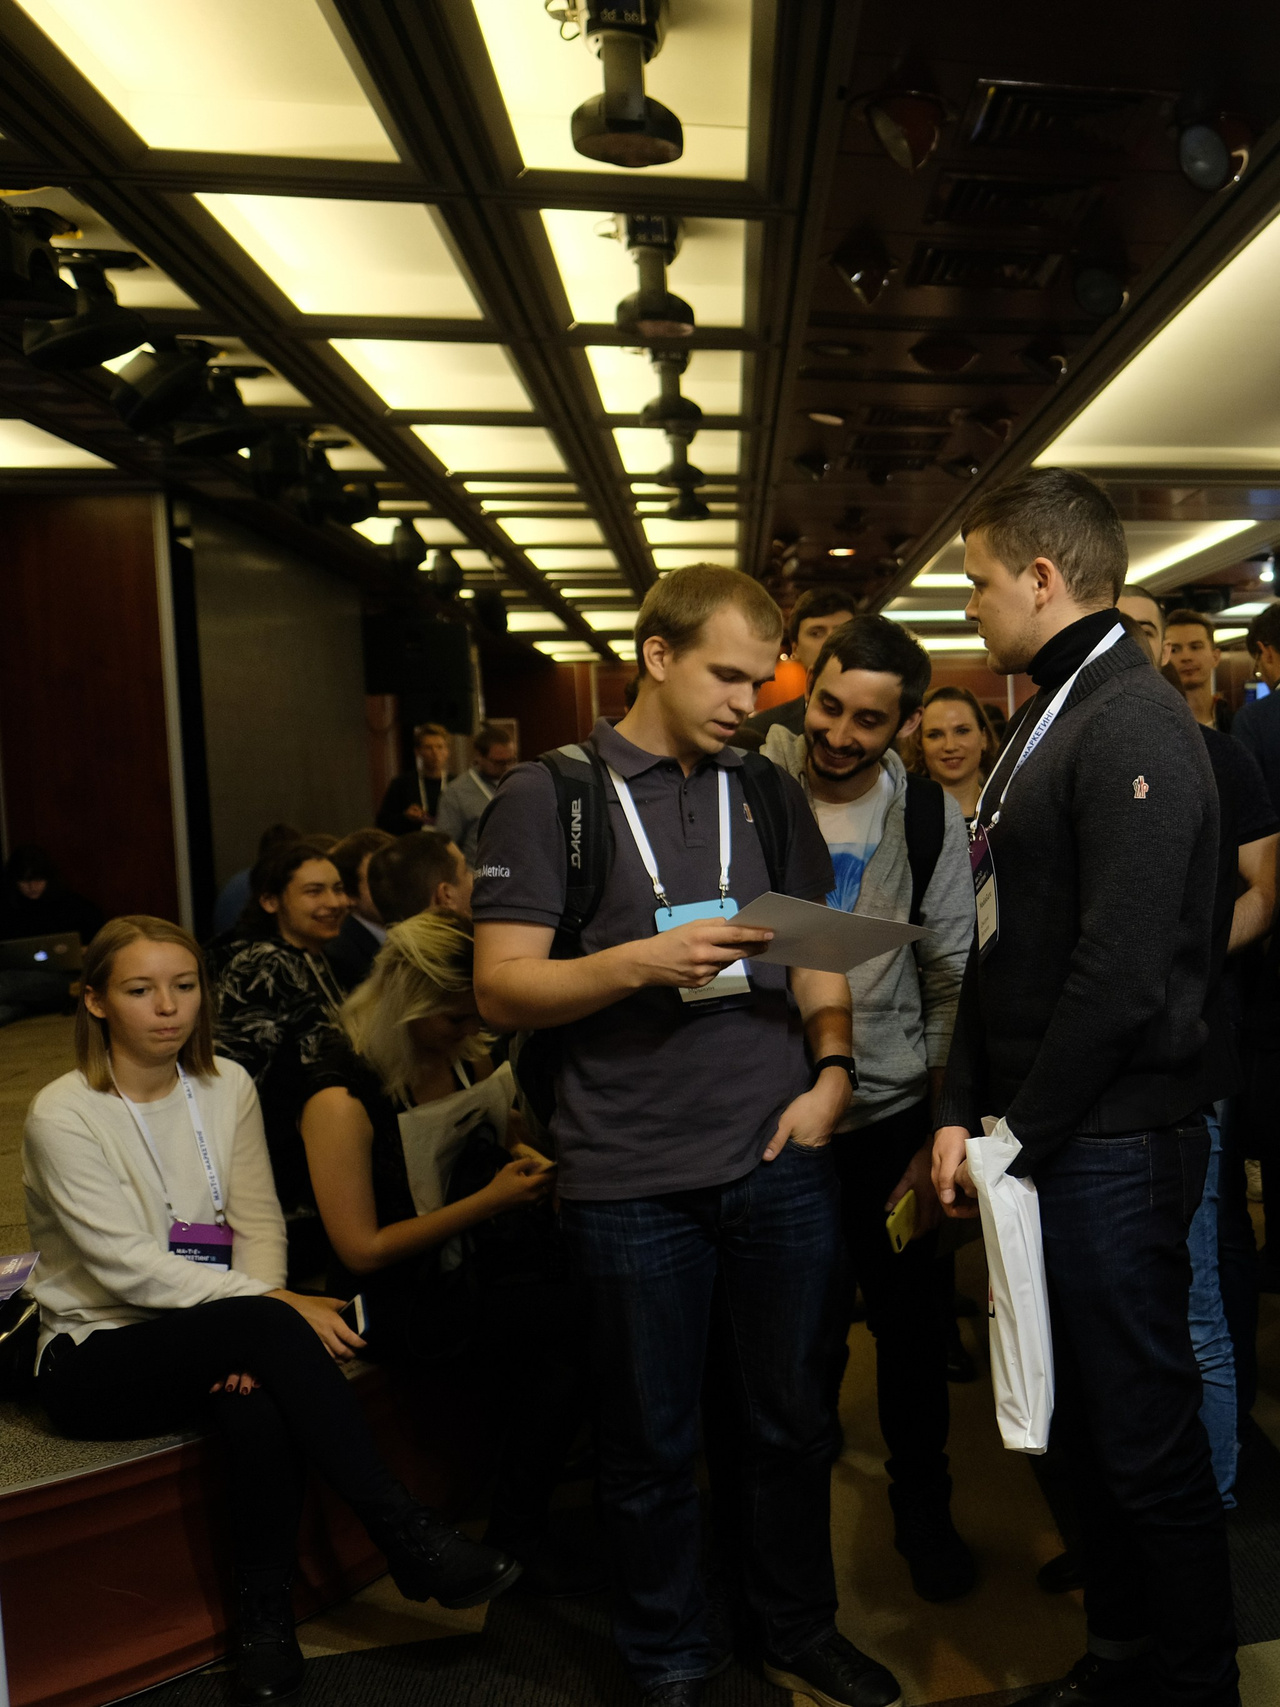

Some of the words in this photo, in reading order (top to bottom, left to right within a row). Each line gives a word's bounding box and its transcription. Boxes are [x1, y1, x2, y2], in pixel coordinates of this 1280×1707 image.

[1022, 709, 1054, 759] МАРКЕТИНГ
[571, 797, 582, 870] DAKINE
[482, 864, 511, 878] Metrica
